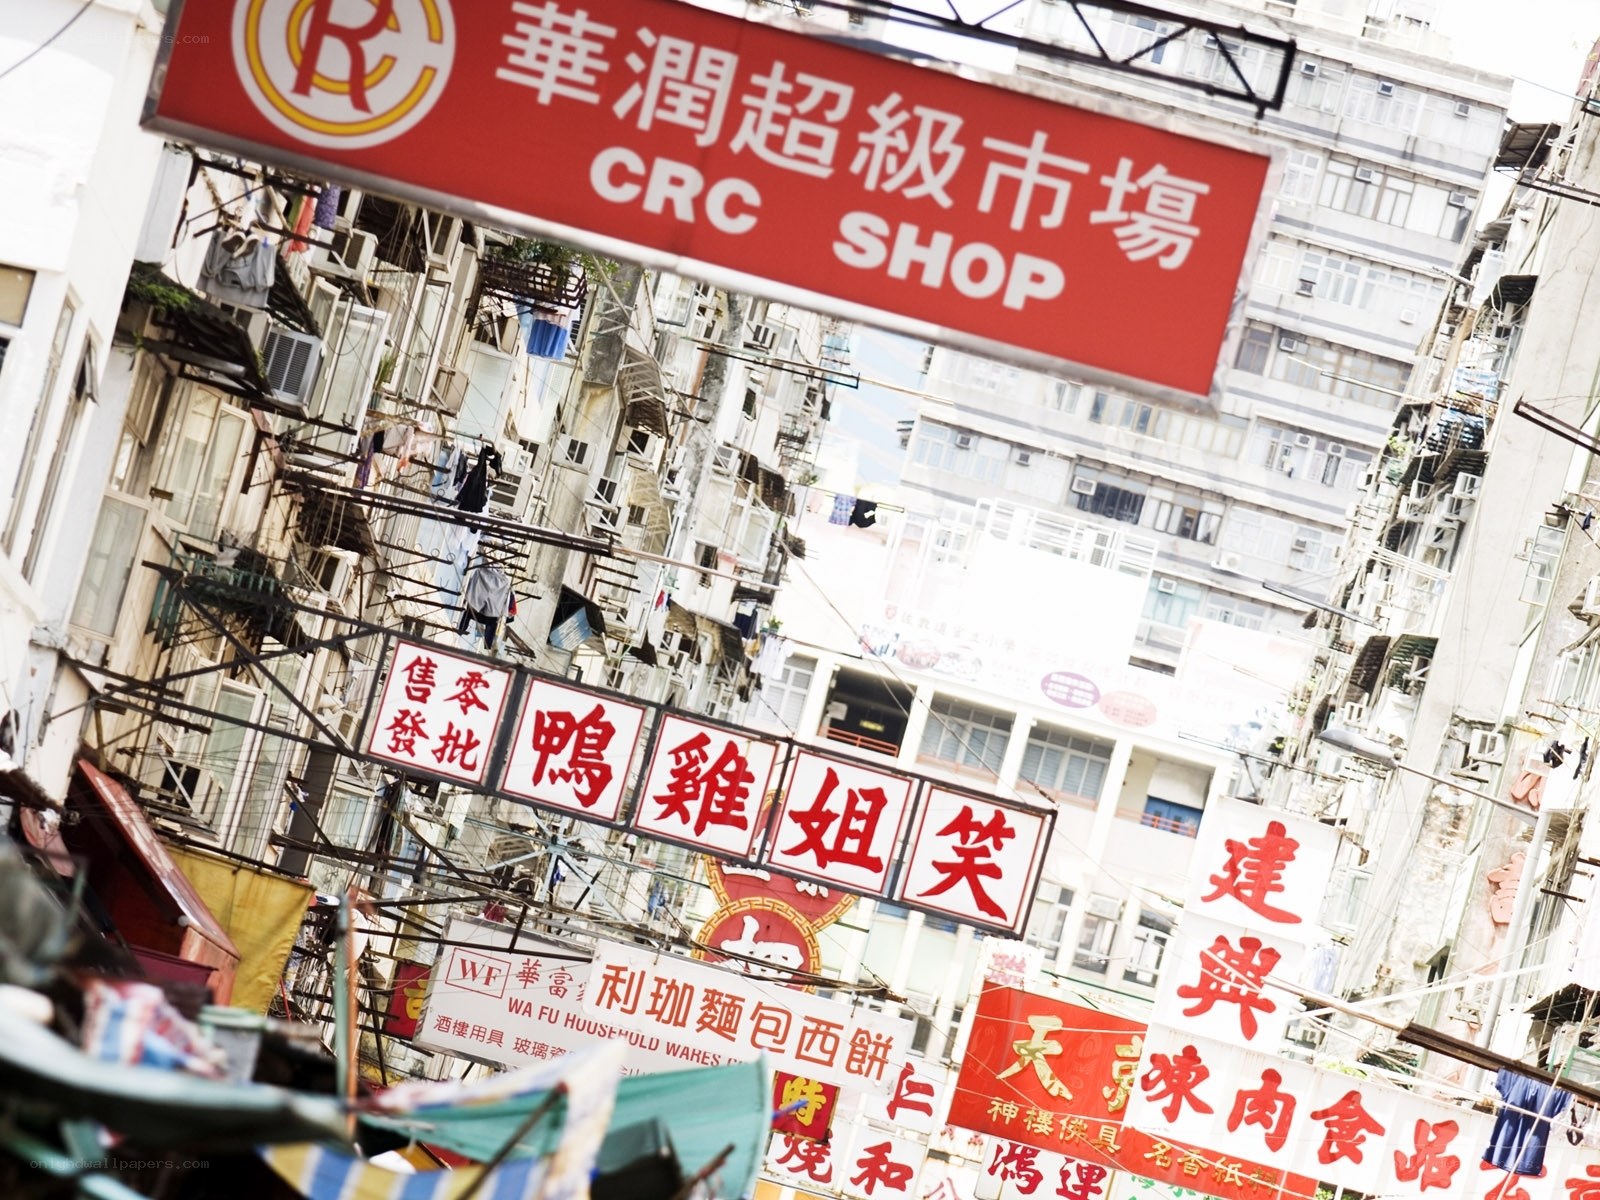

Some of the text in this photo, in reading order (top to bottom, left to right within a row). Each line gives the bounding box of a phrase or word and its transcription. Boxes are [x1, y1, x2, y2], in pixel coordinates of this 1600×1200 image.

[590, 147, 1066, 311] CRC SHOP
[459, 957, 503, 988] WF
[432, 1014, 505, 1047] 酒樓用具
[508, 997, 533, 1018] WA
[538, 1005, 561, 1024] FU
[665, 1041, 722, 1068] WARES
